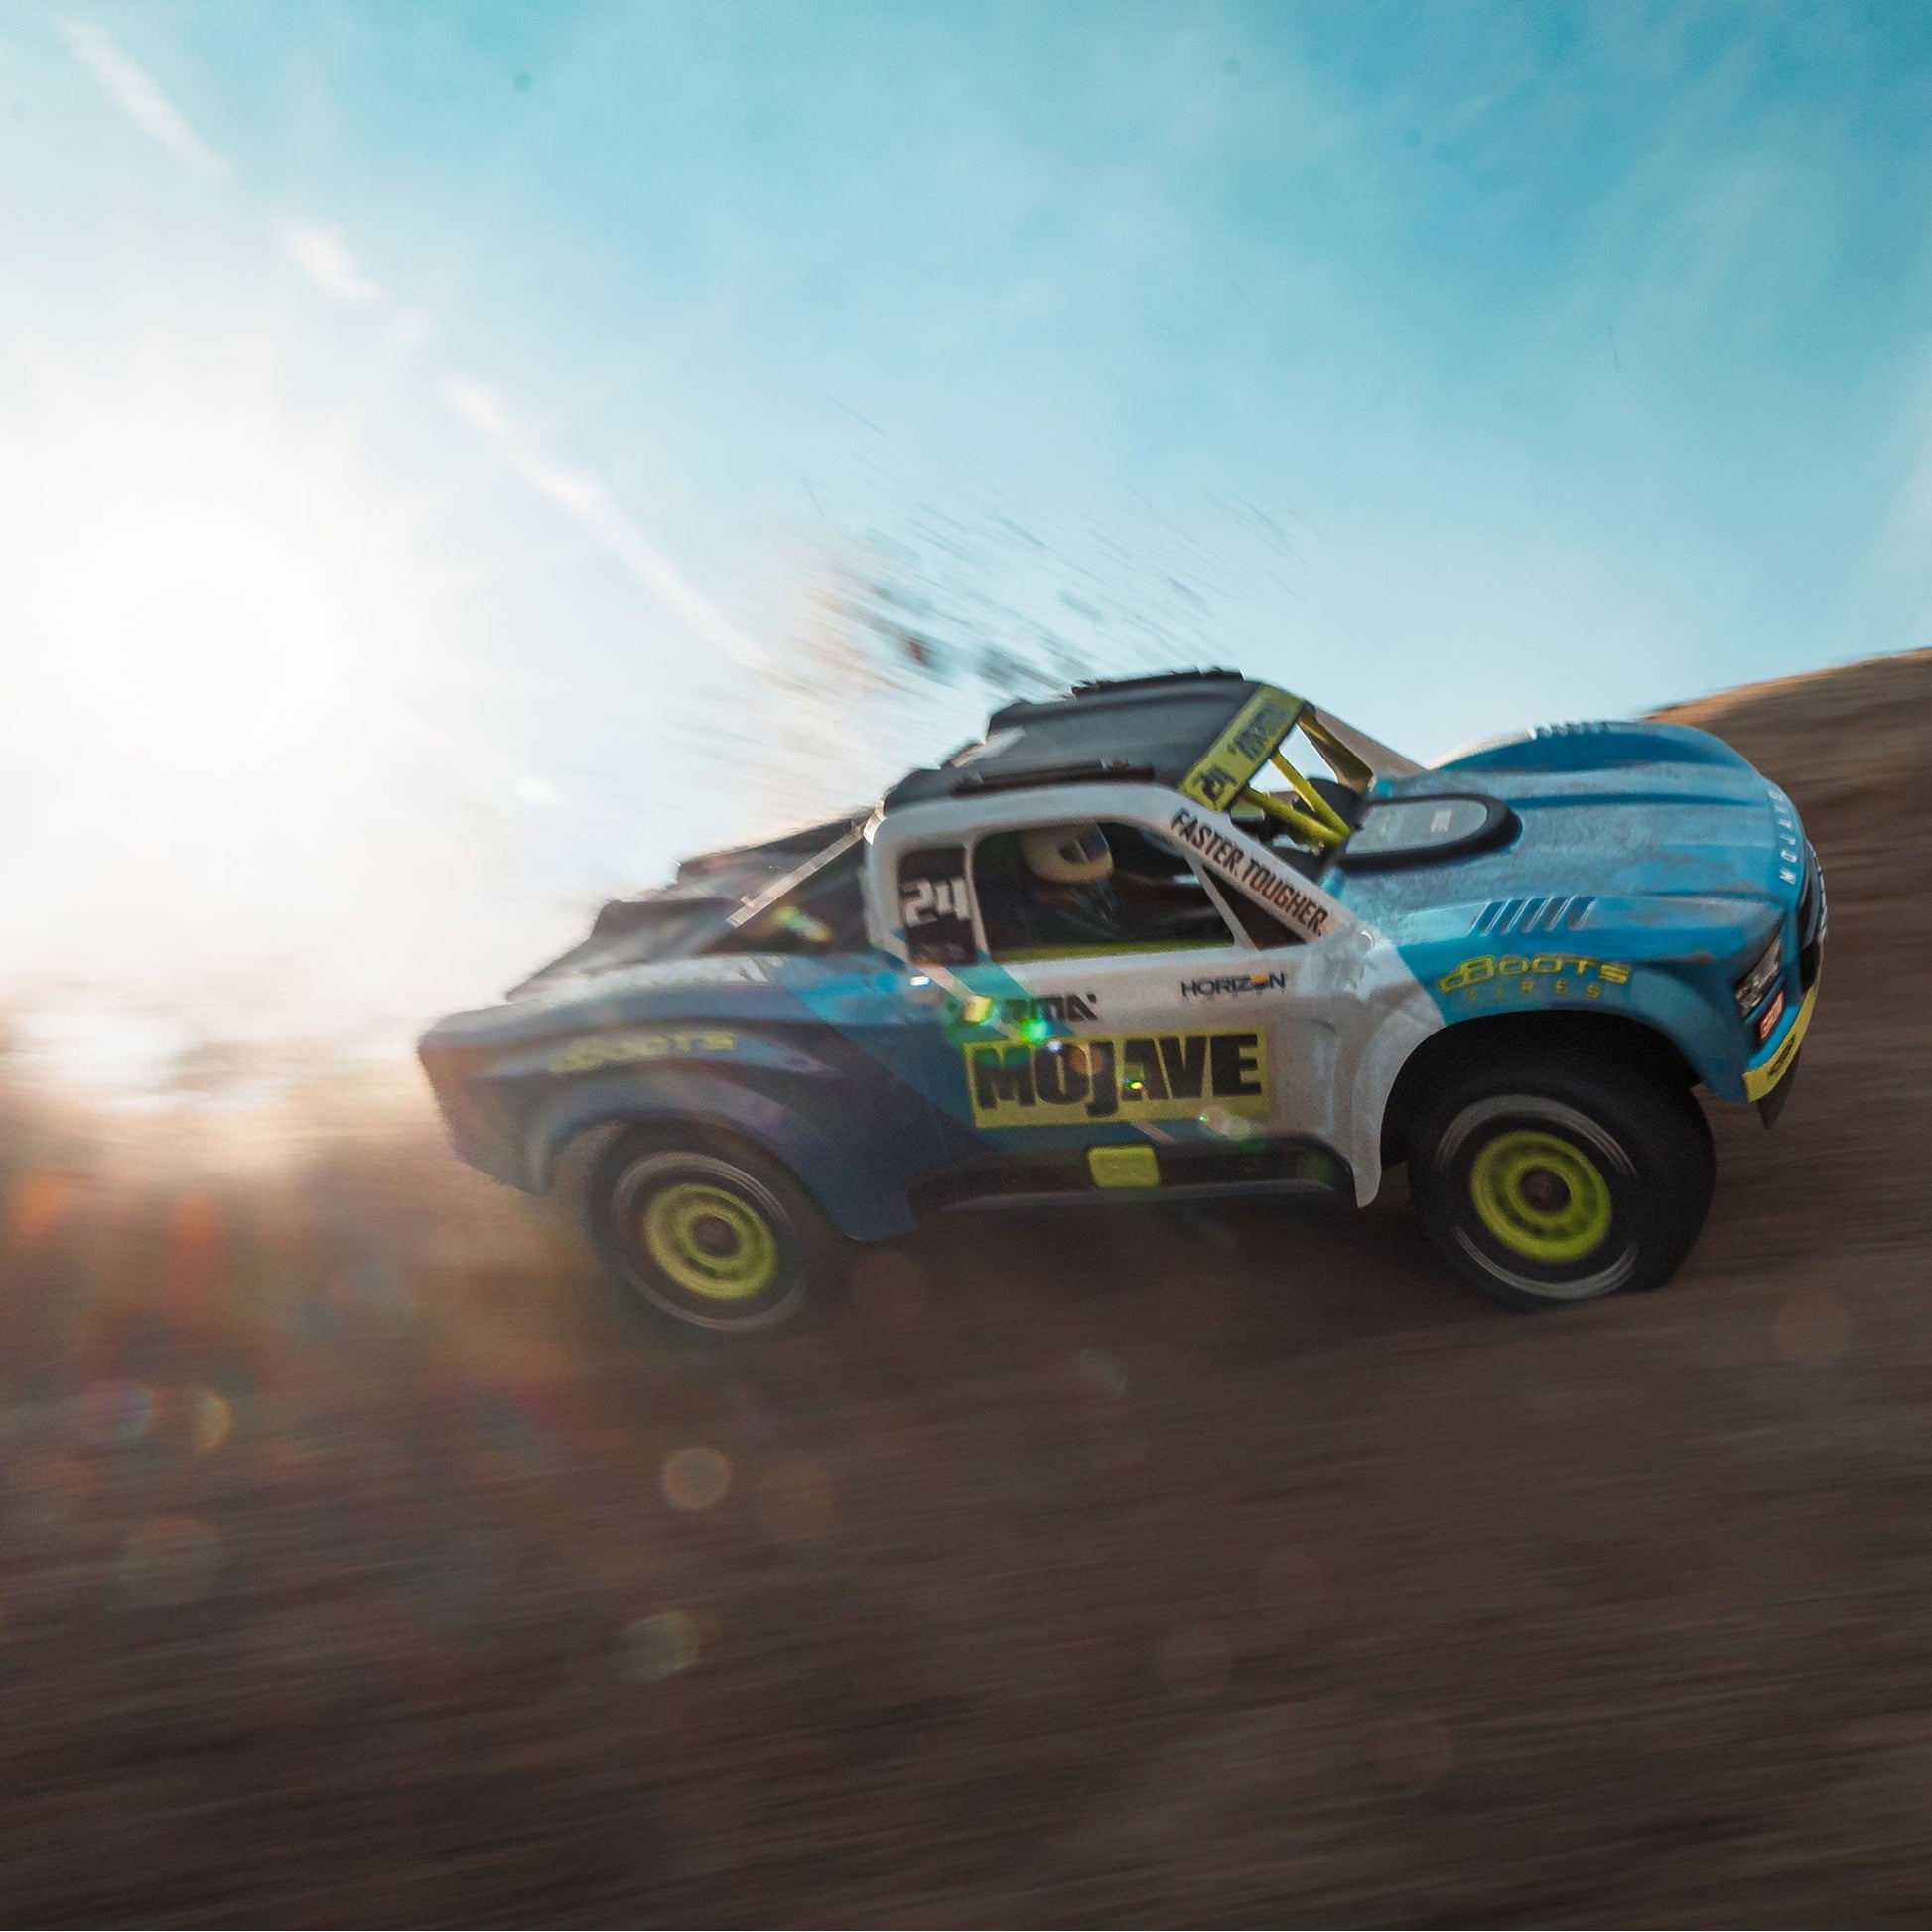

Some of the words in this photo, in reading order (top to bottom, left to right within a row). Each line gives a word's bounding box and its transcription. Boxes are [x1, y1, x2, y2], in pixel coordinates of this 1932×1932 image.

[1170, 808, 1244, 876] FASTER.
[1242, 858, 1329, 937] TOUGHER.
[1181, 970, 1286, 997] HORIZON
[973, 1033, 1263, 1117] MOJAVE
